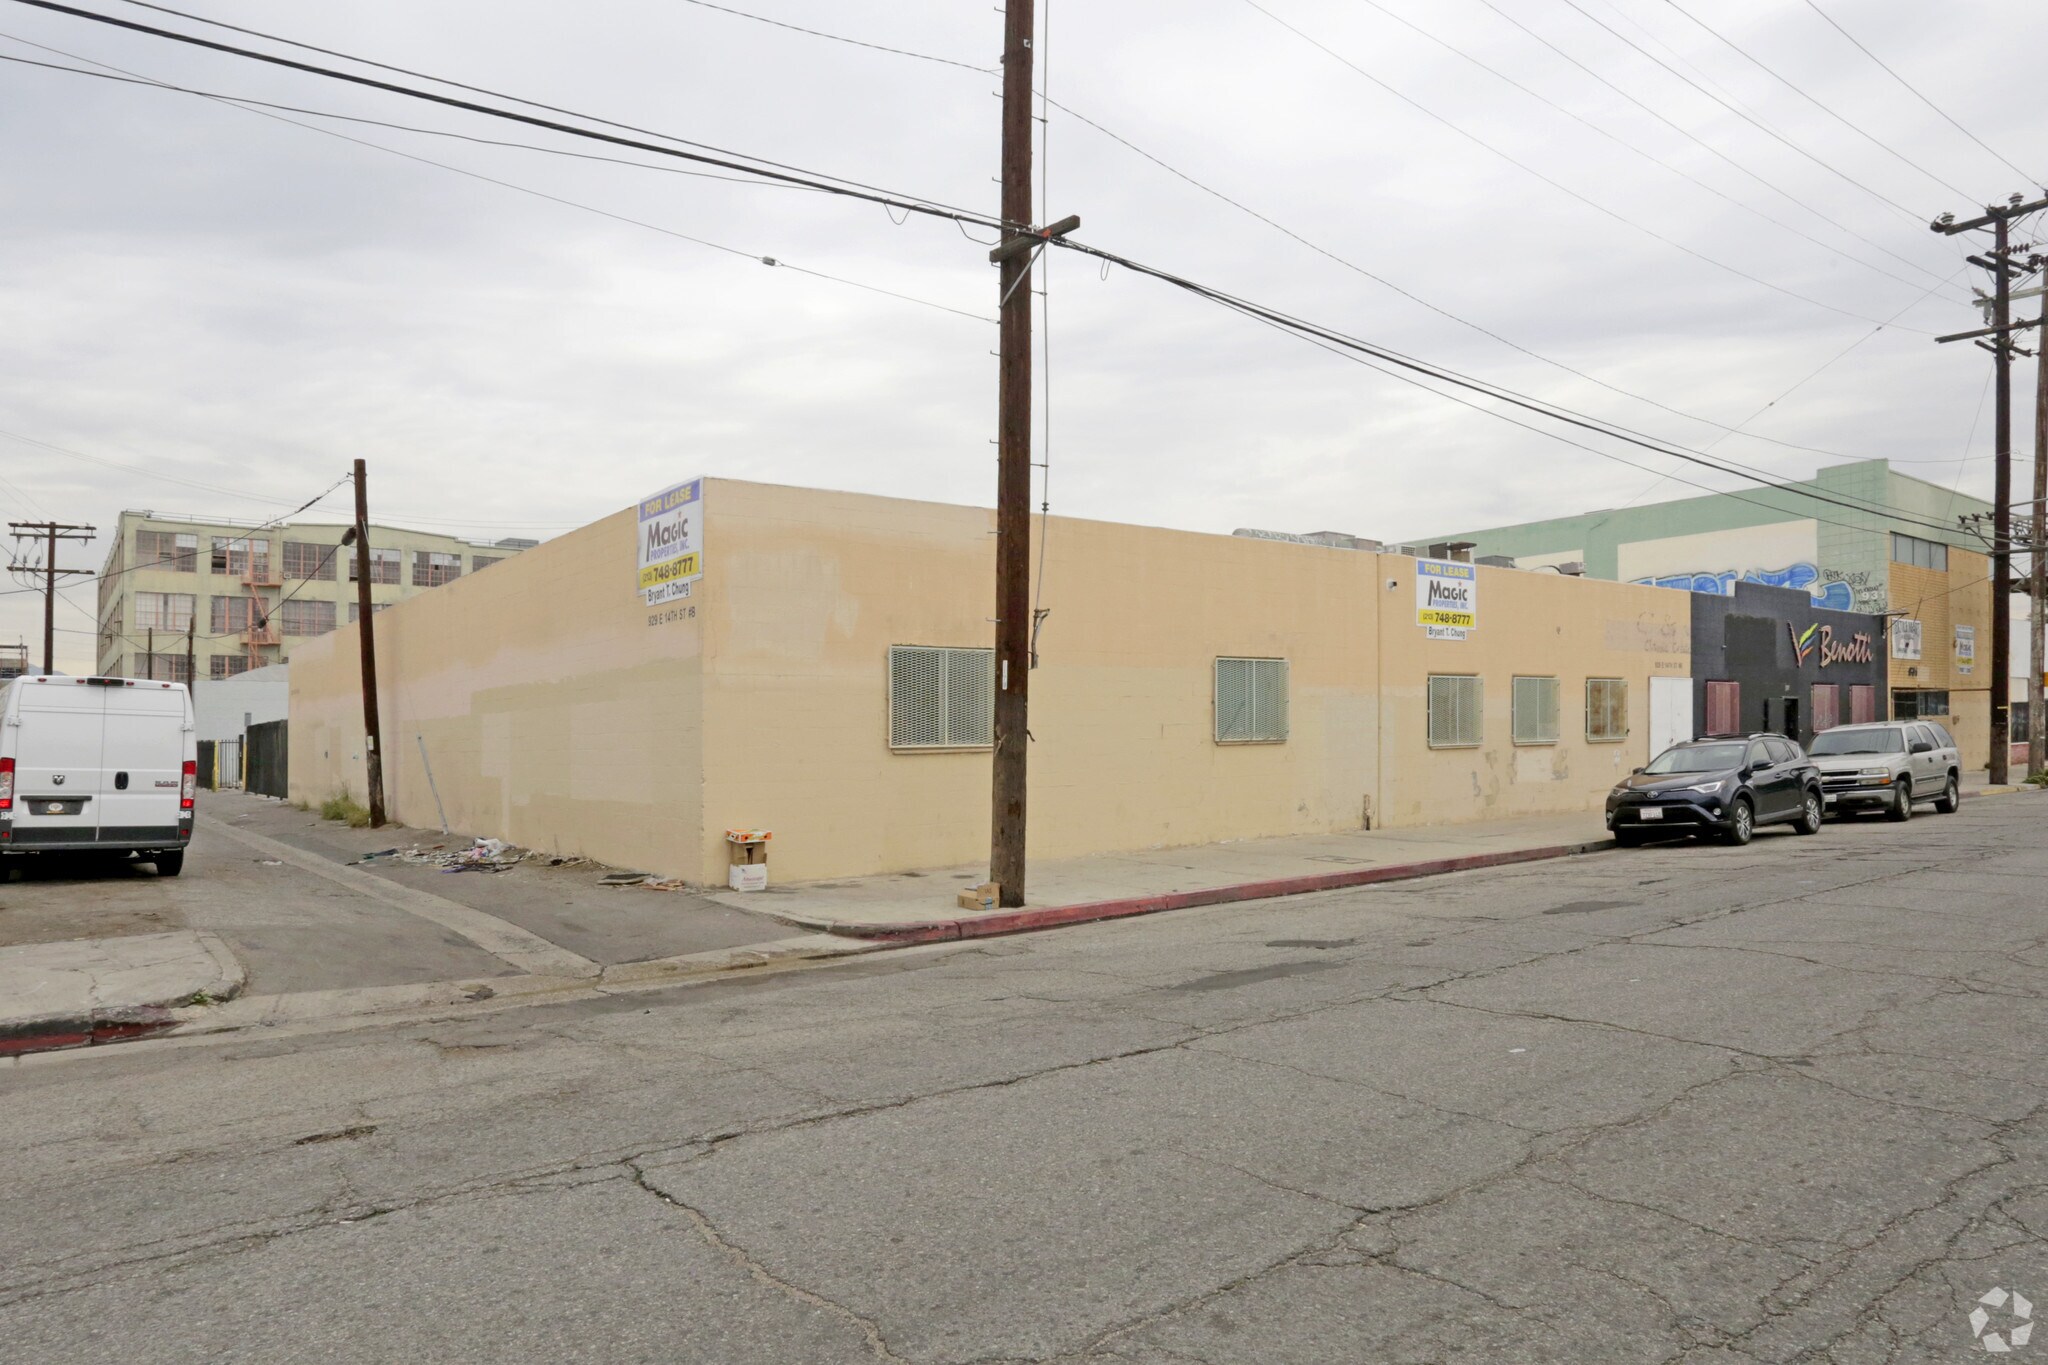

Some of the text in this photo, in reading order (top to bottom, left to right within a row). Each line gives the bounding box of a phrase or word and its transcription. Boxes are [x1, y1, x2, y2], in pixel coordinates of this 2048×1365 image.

[645, 486, 692, 517] FOR LEASE
[654, 557, 693, 582] 748-8777
[1424, 563, 1469, 577] FOR LEASE
[648, 587, 666, 604] Bryant
[672, 582, 689, 596] Chung
[1861, 590, 1885, 601] 931
[680, 608, 686, 620] ST
[1435, 612, 1471, 625] 748-8777
[1428, 626, 1444, 637] Bryant
[1451, 628, 1466, 639] Chung
[1819, 625, 1873, 668] Benotti
